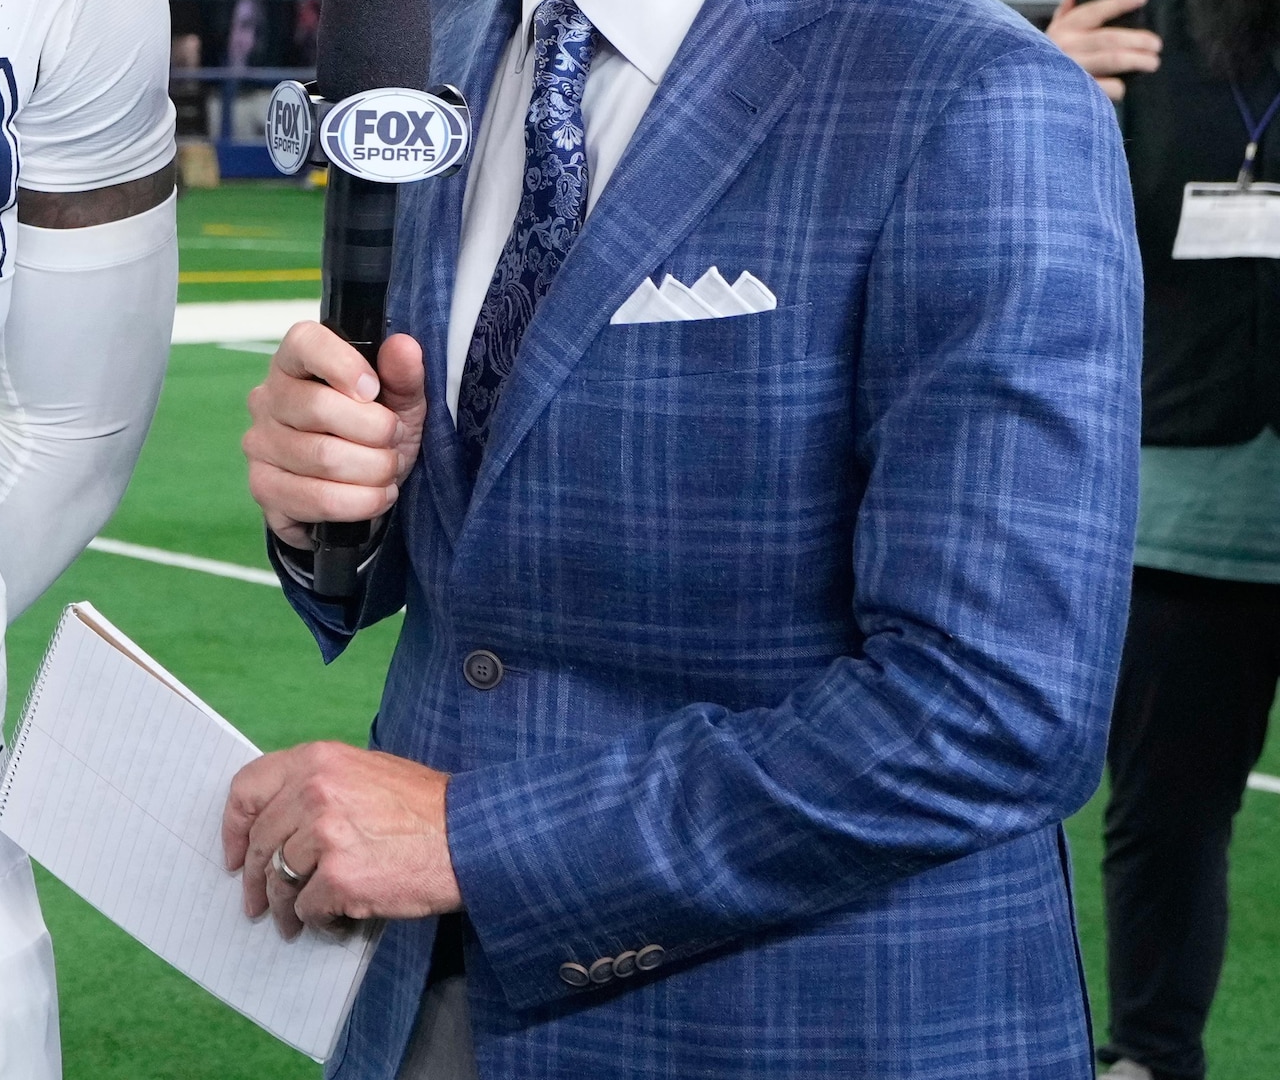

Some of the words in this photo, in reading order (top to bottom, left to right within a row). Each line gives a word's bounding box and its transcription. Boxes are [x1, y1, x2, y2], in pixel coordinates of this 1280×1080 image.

[274, 100, 302, 140] FOX
[354, 109, 435, 147] FOX
[273, 137, 301, 156] SPORTS
[352, 146, 436, 162] SPORTS
